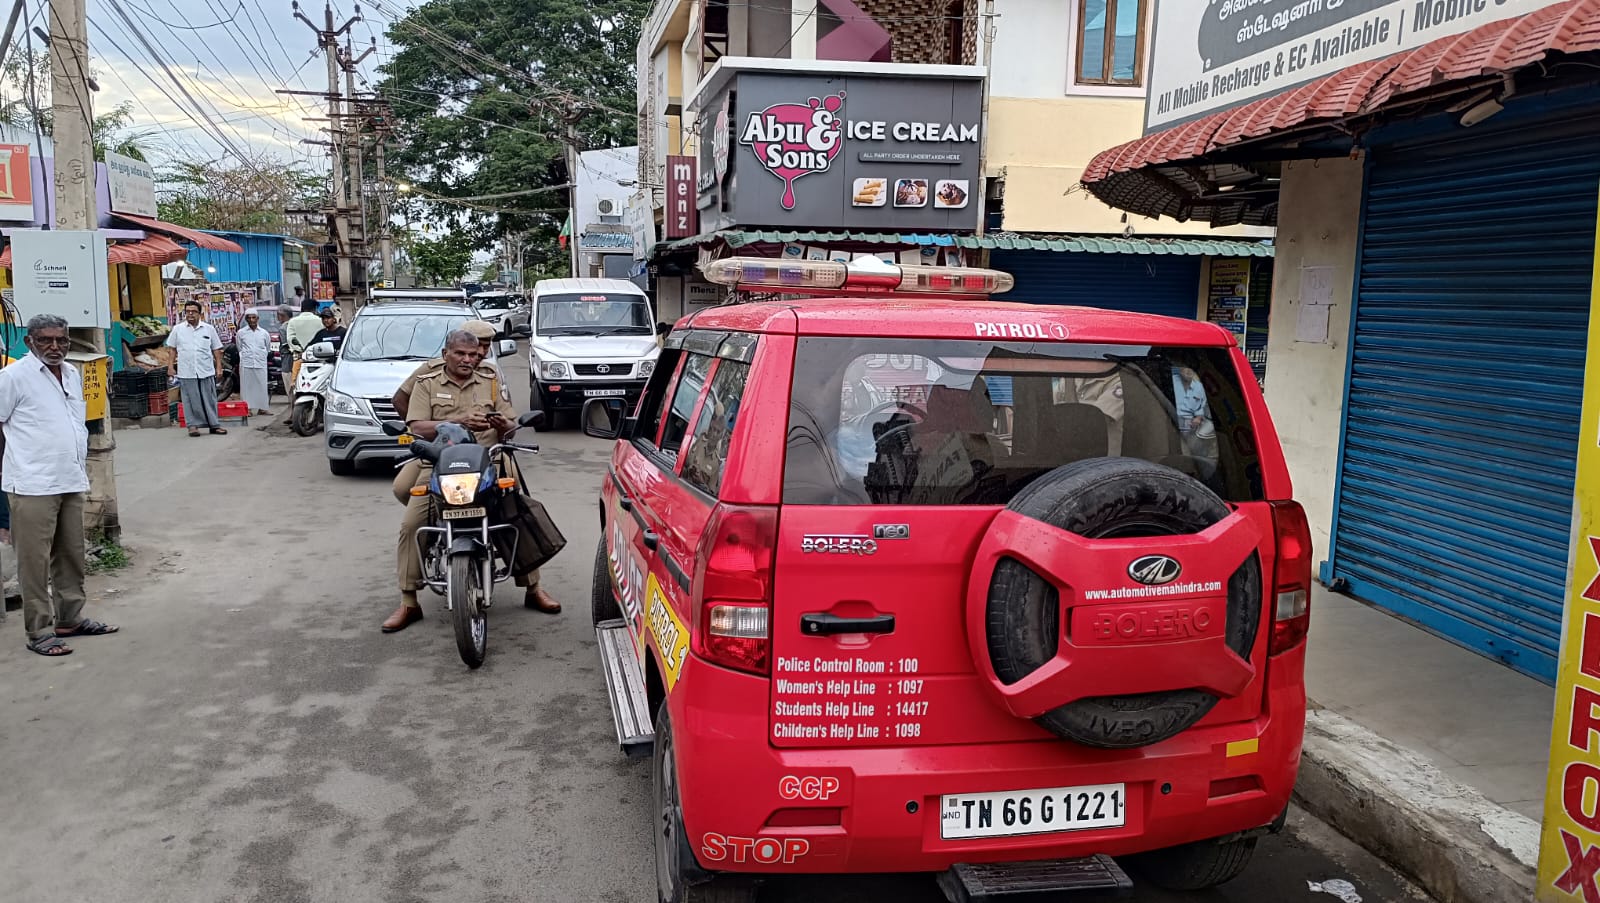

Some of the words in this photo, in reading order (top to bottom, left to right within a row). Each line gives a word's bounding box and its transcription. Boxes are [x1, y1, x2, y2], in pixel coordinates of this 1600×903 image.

[1157, 91, 1171, 115] All
[1173, 80, 1208, 111] Mobile
[1212, 59, 1270, 97] Recharge
[1274, 52, 1285, 78] &
[1288, 43, 1308, 74] EC
[1310, 16, 1390, 65] Available
[742, 114, 804, 143] Abu
[806, 110, 840, 151] &
[847, 120, 886, 140] ICE
[892, 121, 978, 142] CREAM
[766, 144, 828, 169] Sons
[673, 163, 691, 230] menz
[974, 322, 1048, 338] PATROL
[876, 525, 907, 538] neo
[801, 537, 877, 556] BOLERO
[1085, 581, 1221, 600] www.automotivemahindra.com
[650, 588, 679, 671] PATROL
[1094, 606, 1210, 640] BOLERO
[777, 657, 810, 672] Police
[814, 657, 852, 673] Control
[856, 658, 885, 673] Room
[898, 658, 918, 673] 100
[776, 679, 824, 694] Women's
[827, 680, 850, 697] Help
[853, 680, 876, 695] Line
[897, 680, 924, 694] 1097
[775, 701, 822, 716] Students
[825, 702, 849, 719] Help
[852, 702, 875, 716] Line
[896, 702, 929, 716] 14417
[774, 723, 827, 738] Children's
[830, 724, 854, 740] Help
[857, 724, 879, 738] Line
[895, 723, 921, 737] 1098
[779, 775, 839, 800] CCP
[962, 799, 992, 829] TN
[1003, 797, 1032, 826] 66
[1041, 795, 1054, 823] G
[1064, 790, 1119, 821] 1221
[702, 832, 809, 864] STOP
